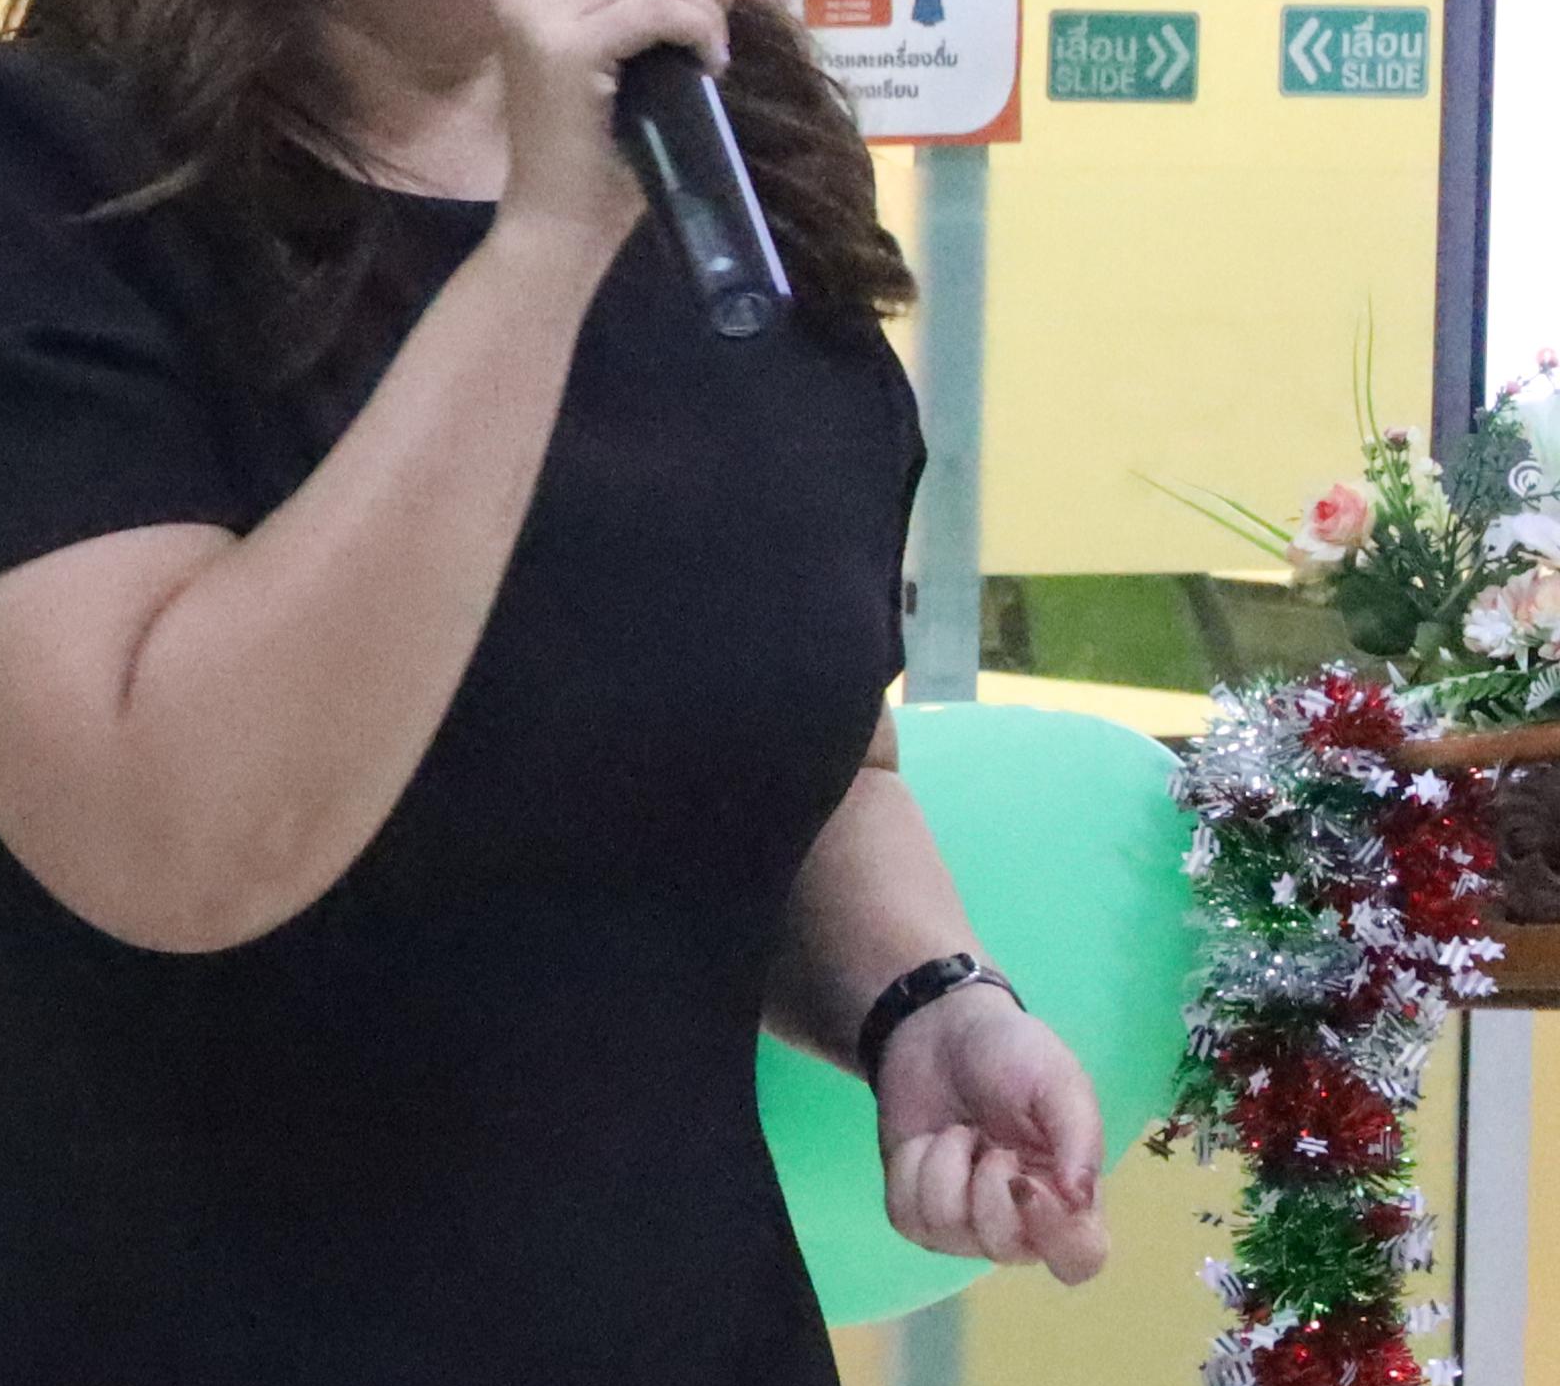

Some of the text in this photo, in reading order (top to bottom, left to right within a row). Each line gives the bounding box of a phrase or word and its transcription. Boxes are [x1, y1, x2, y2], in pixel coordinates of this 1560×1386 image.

[1056, 17, 1137, 62] เลื่อน
[1342, 15, 1423, 59] เลื่อน
[1056, 64, 1137, 93] SLIDE
[1342, 62, 1420, 89] SLIDE
